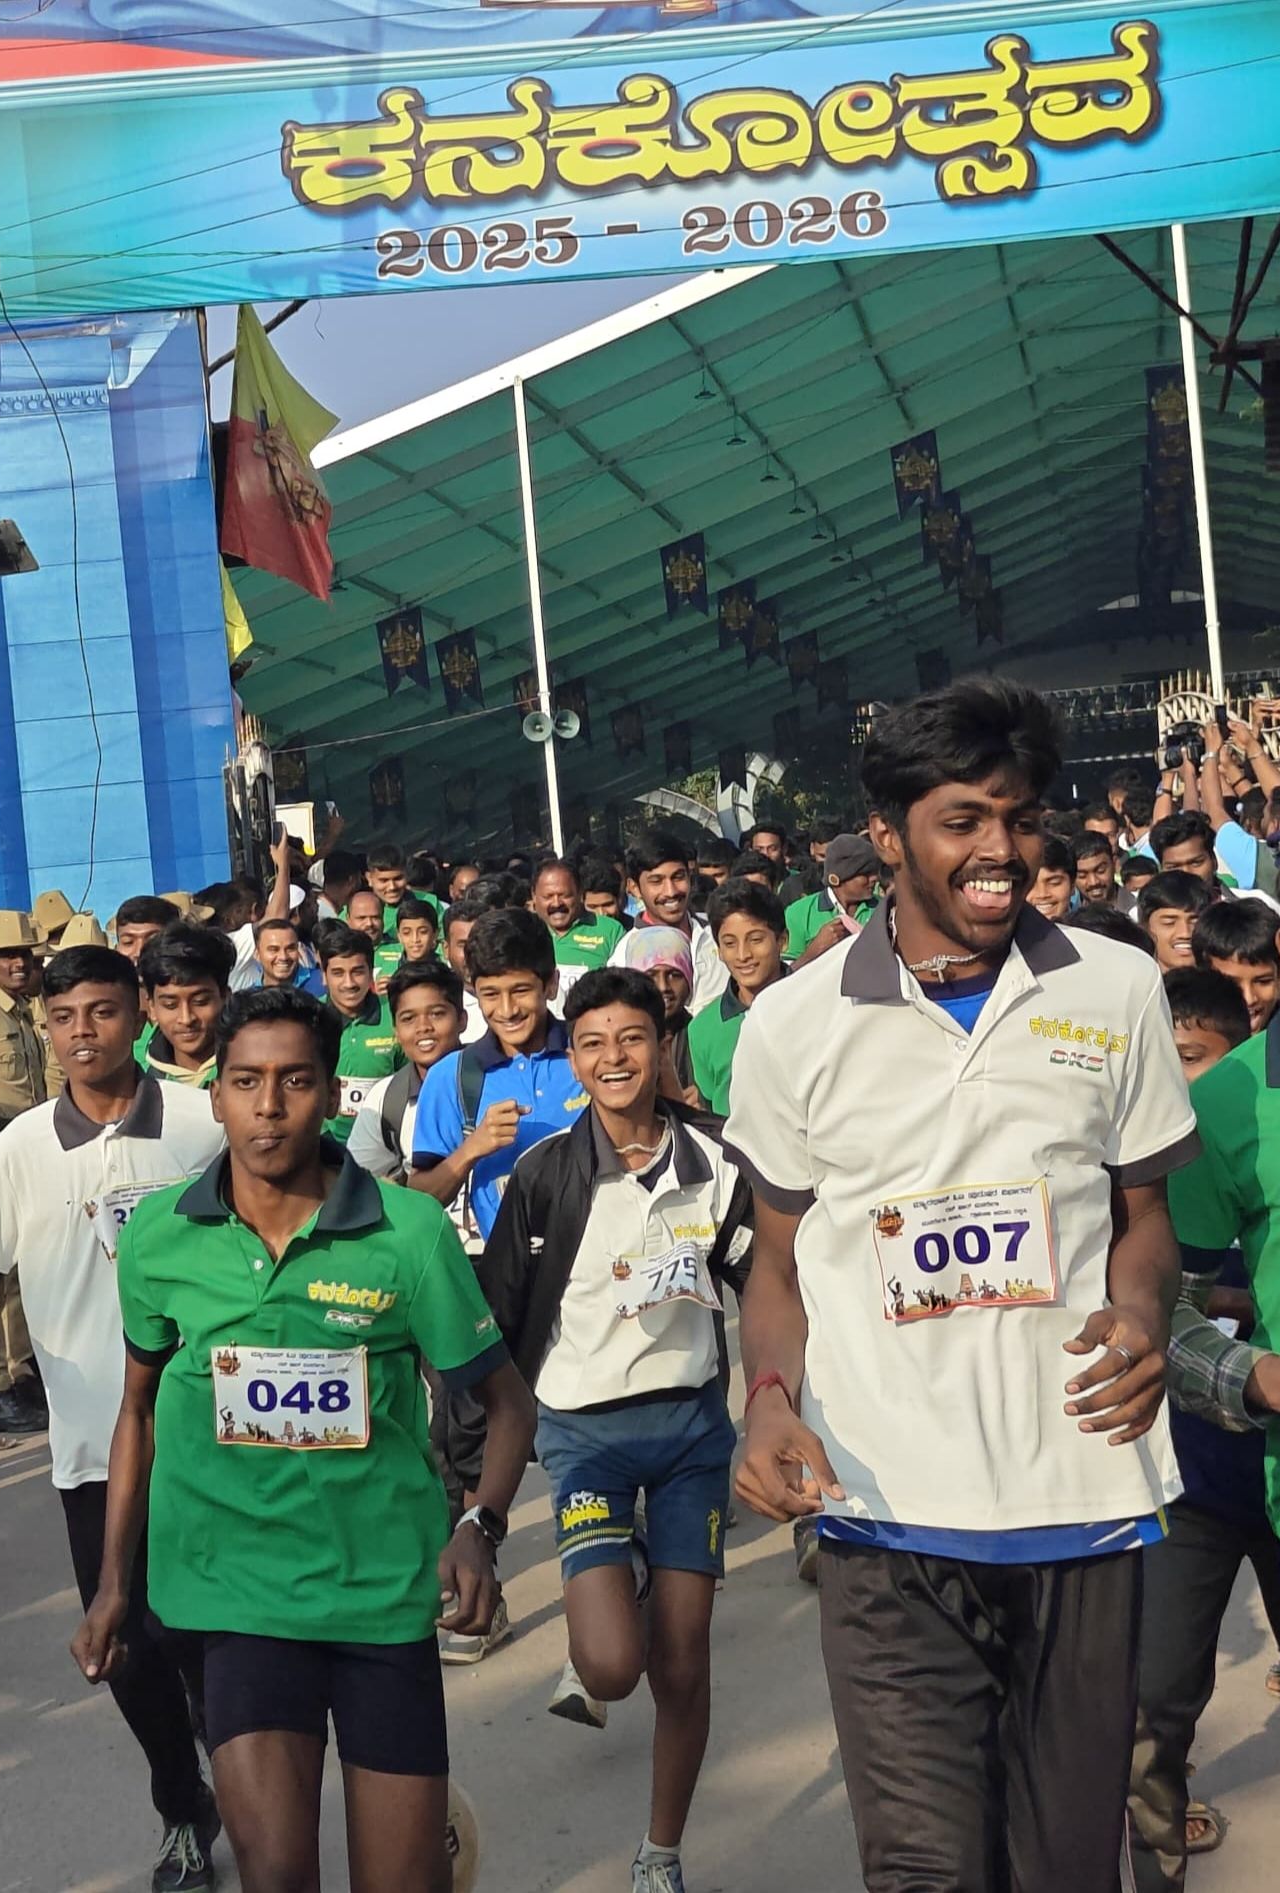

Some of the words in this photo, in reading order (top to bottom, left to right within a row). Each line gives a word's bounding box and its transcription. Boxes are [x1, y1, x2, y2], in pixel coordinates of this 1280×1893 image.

[283, 21, 1159, 207] ಕನಕೋತ್ಸವ
[376, 216, 580, 278] 2025
[682, 191, 890, 256] 2026
[1049, 1049, 1105, 1072] DKS
[914, 1221, 1030, 1273] 007
[647, 1256, 698, 1292] 775
[246, 1379, 351, 1415] 048
